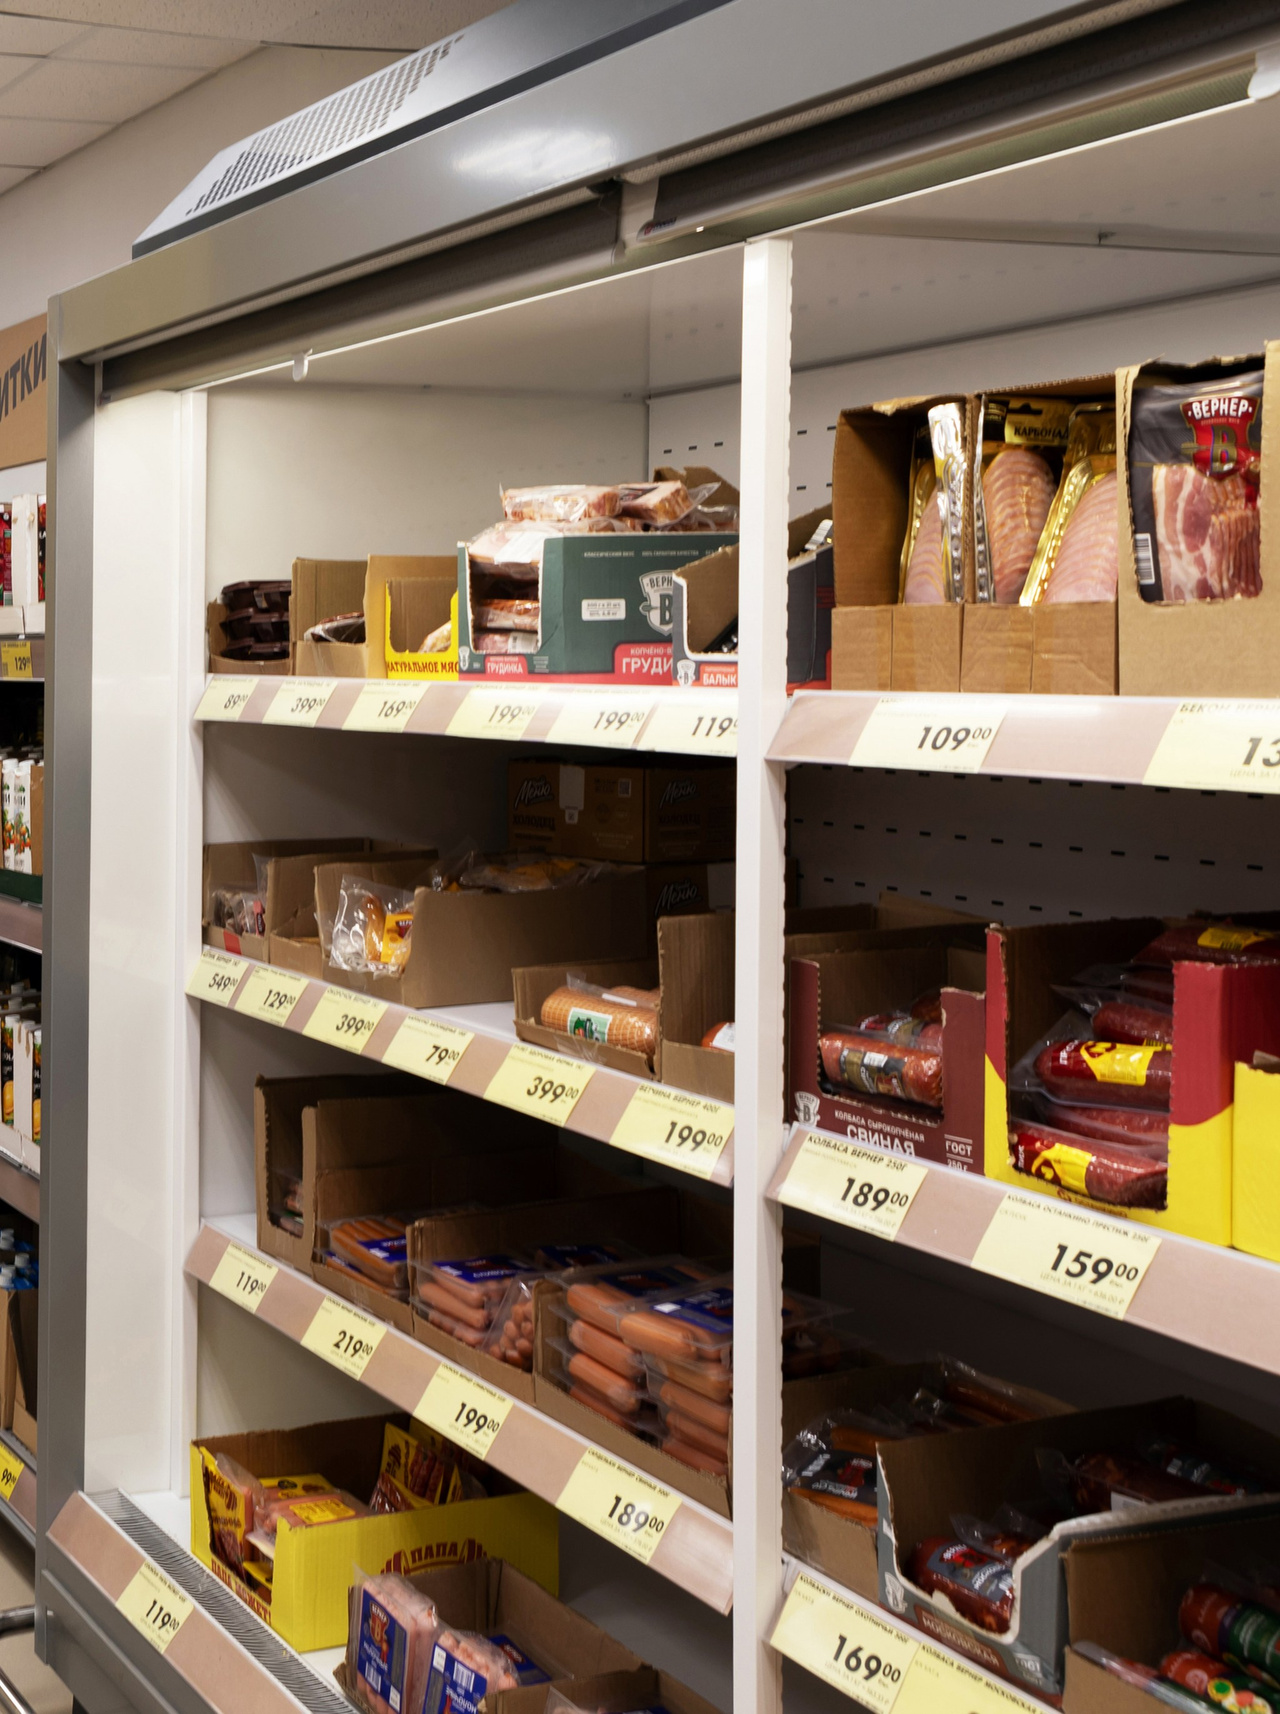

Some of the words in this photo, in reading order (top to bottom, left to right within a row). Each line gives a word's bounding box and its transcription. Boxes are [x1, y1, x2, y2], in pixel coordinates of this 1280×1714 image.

[1191, 398, 1249, 420] ВЕРНЕР
[487, 663, 523, 675] ГРУДИНКА
[702, 673, 736, 685] БАЛЫК
[834, 1109, 866, 1126] КОЛБАСА
[867, 1117, 925, 1143] СЫРОКОПЧЁНАЯ
[808, 1135, 849, 1154] КОЛБАСА
[850, 1147, 885, 1164] ВЕРНЕР
[885, 1157, 908, 1173] 250Г
[846, 1125, 916, 1158] СВИНАЯ
[945, 1141, 973, 1156] ГОСТ
[1007, 1194, 1041, 1210] КОЛБАСА
[1042, 1204, 1091, 1225] ОСТАНКИНО
[410, 1541, 459, 1564] ПАПА
[211, 1555, 232, 1591] ПАПА
